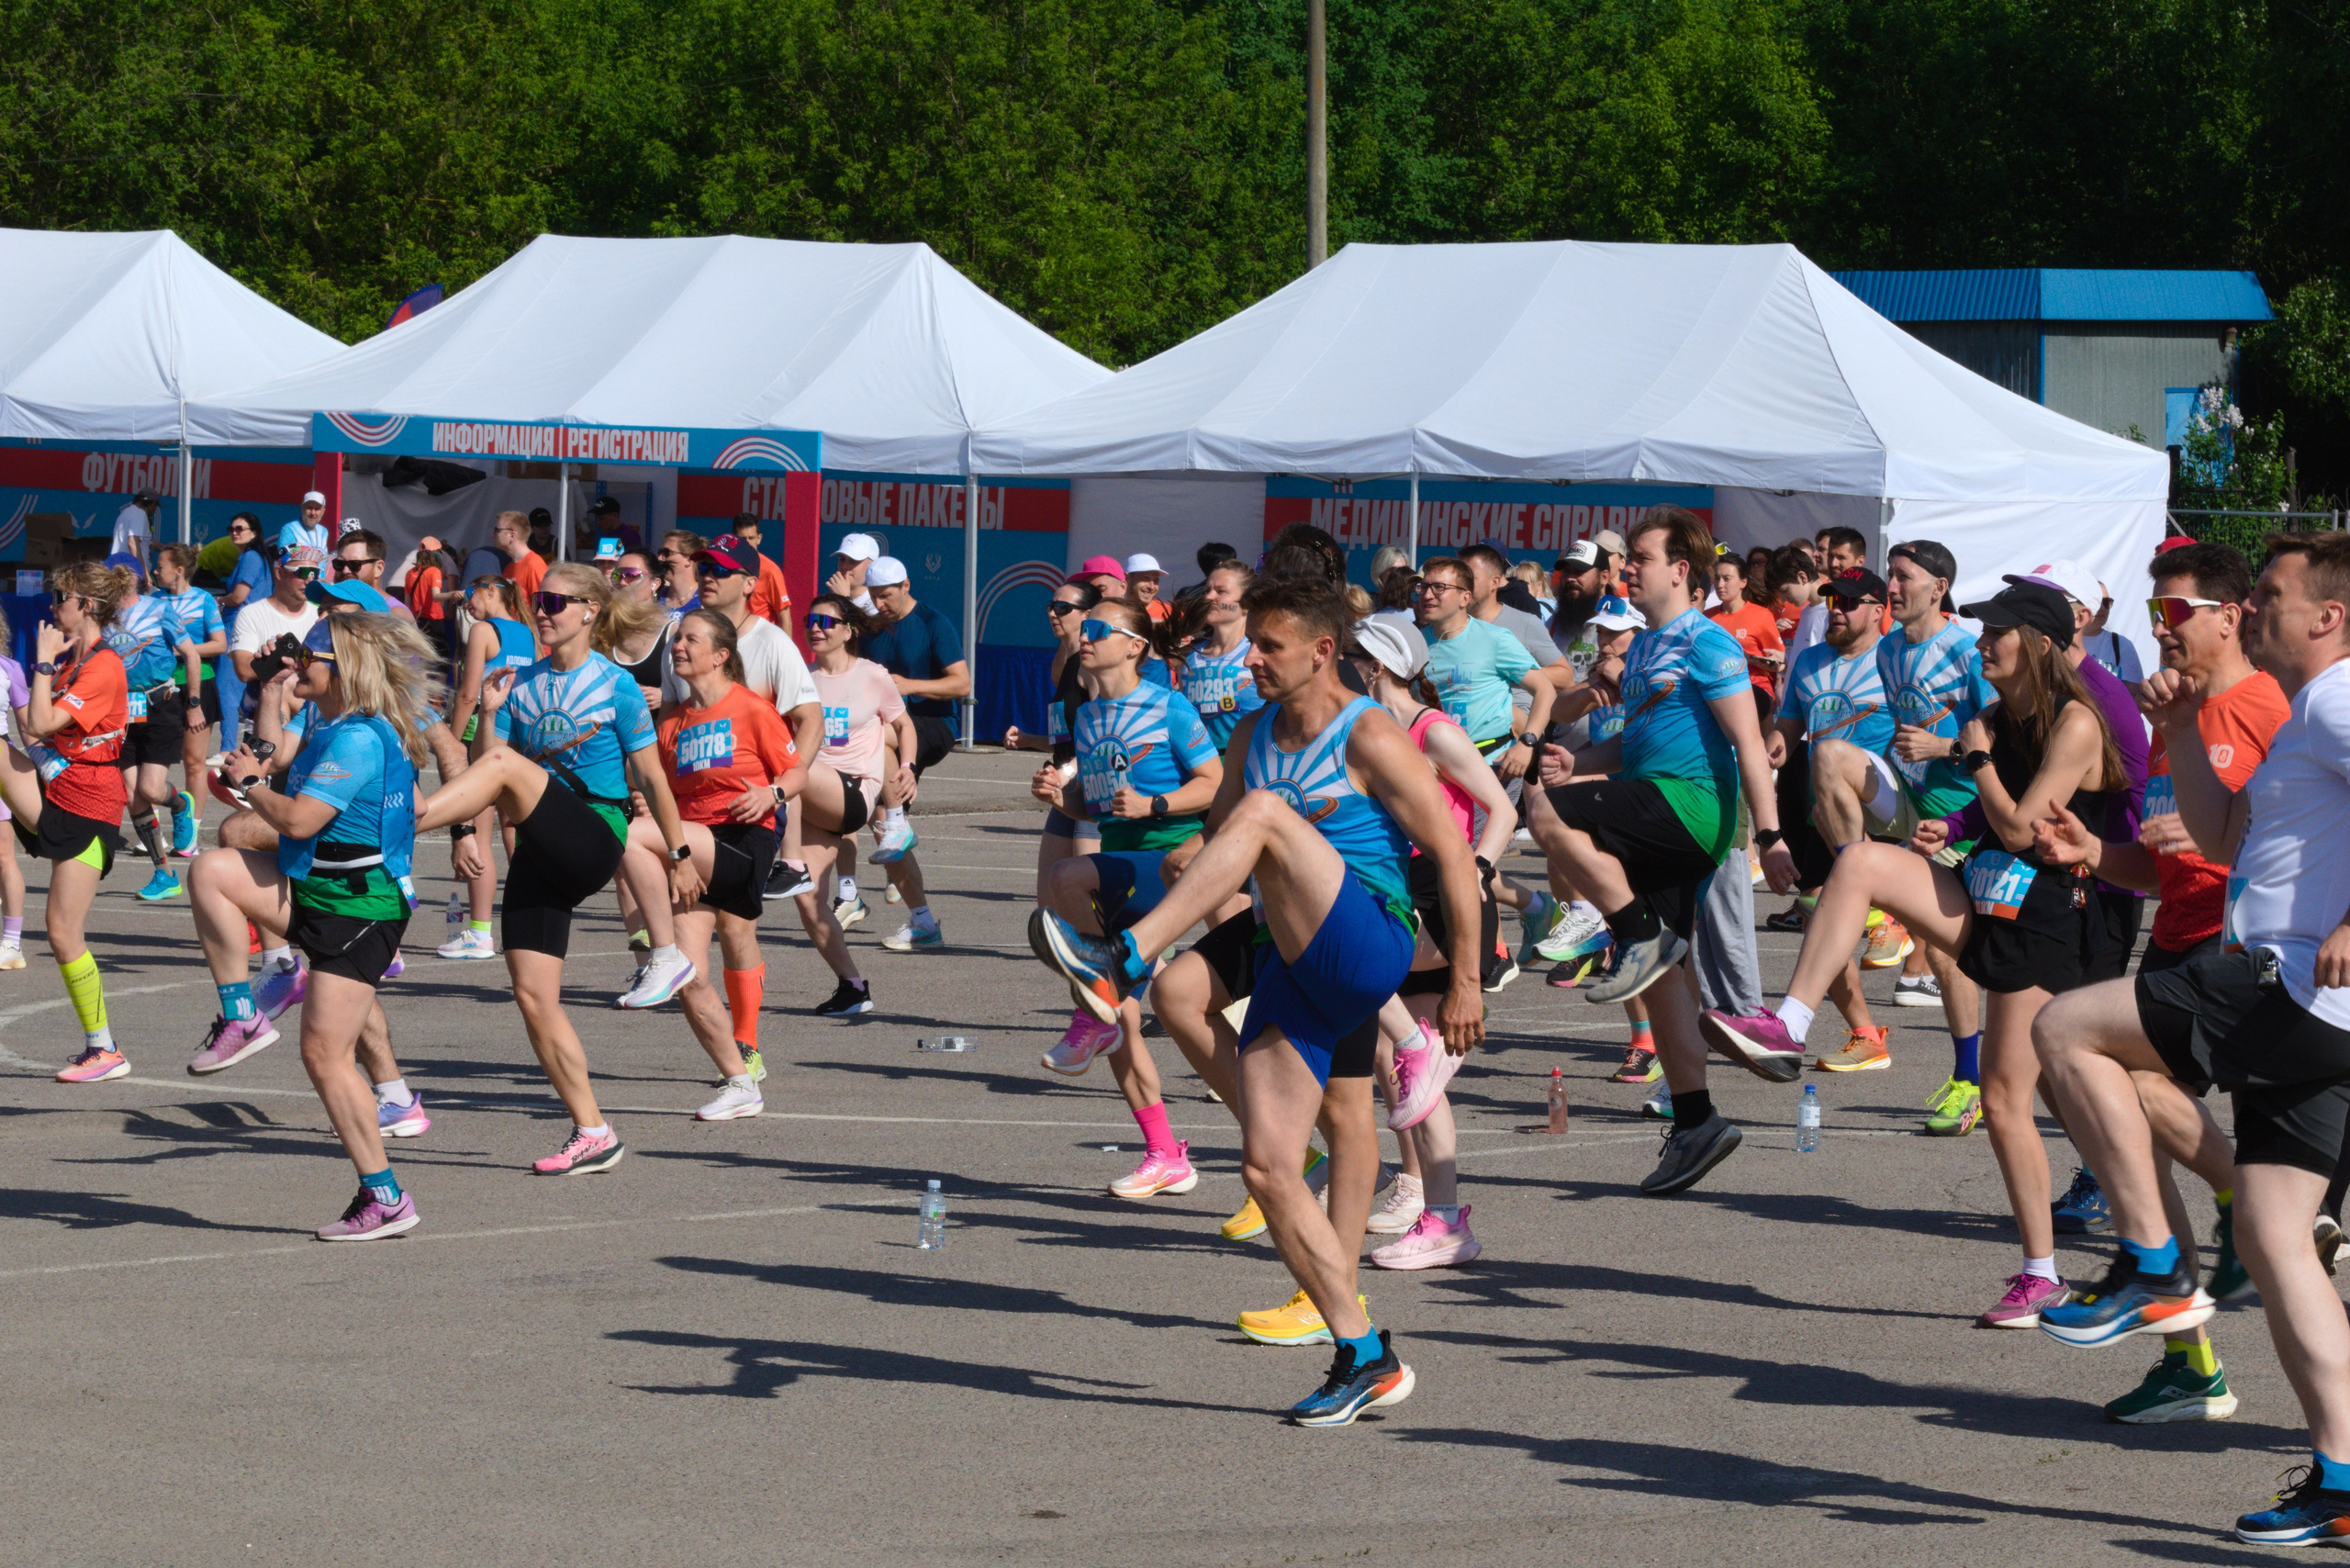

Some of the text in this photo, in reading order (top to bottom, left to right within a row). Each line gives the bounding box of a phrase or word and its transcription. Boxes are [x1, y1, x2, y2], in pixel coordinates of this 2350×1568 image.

[432, 421, 689, 465] ИНФОРМАЦИЯ РЕГИСТРАЦИЯ
[82, 451, 212, 499] ФУТБОЛИ
[742, 476, 1005, 531] СТАОВЫЕ ПАКЕЫ
[1187, 677, 1235, 703] 50293
[1223, 698, 1233, 710] B
[681, 731, 726, 765] 50178
[1114, 754, 1127, 769] A
[2209, 743, 2235, 769] 10
[1969, 867, 2021, 902] 70121
